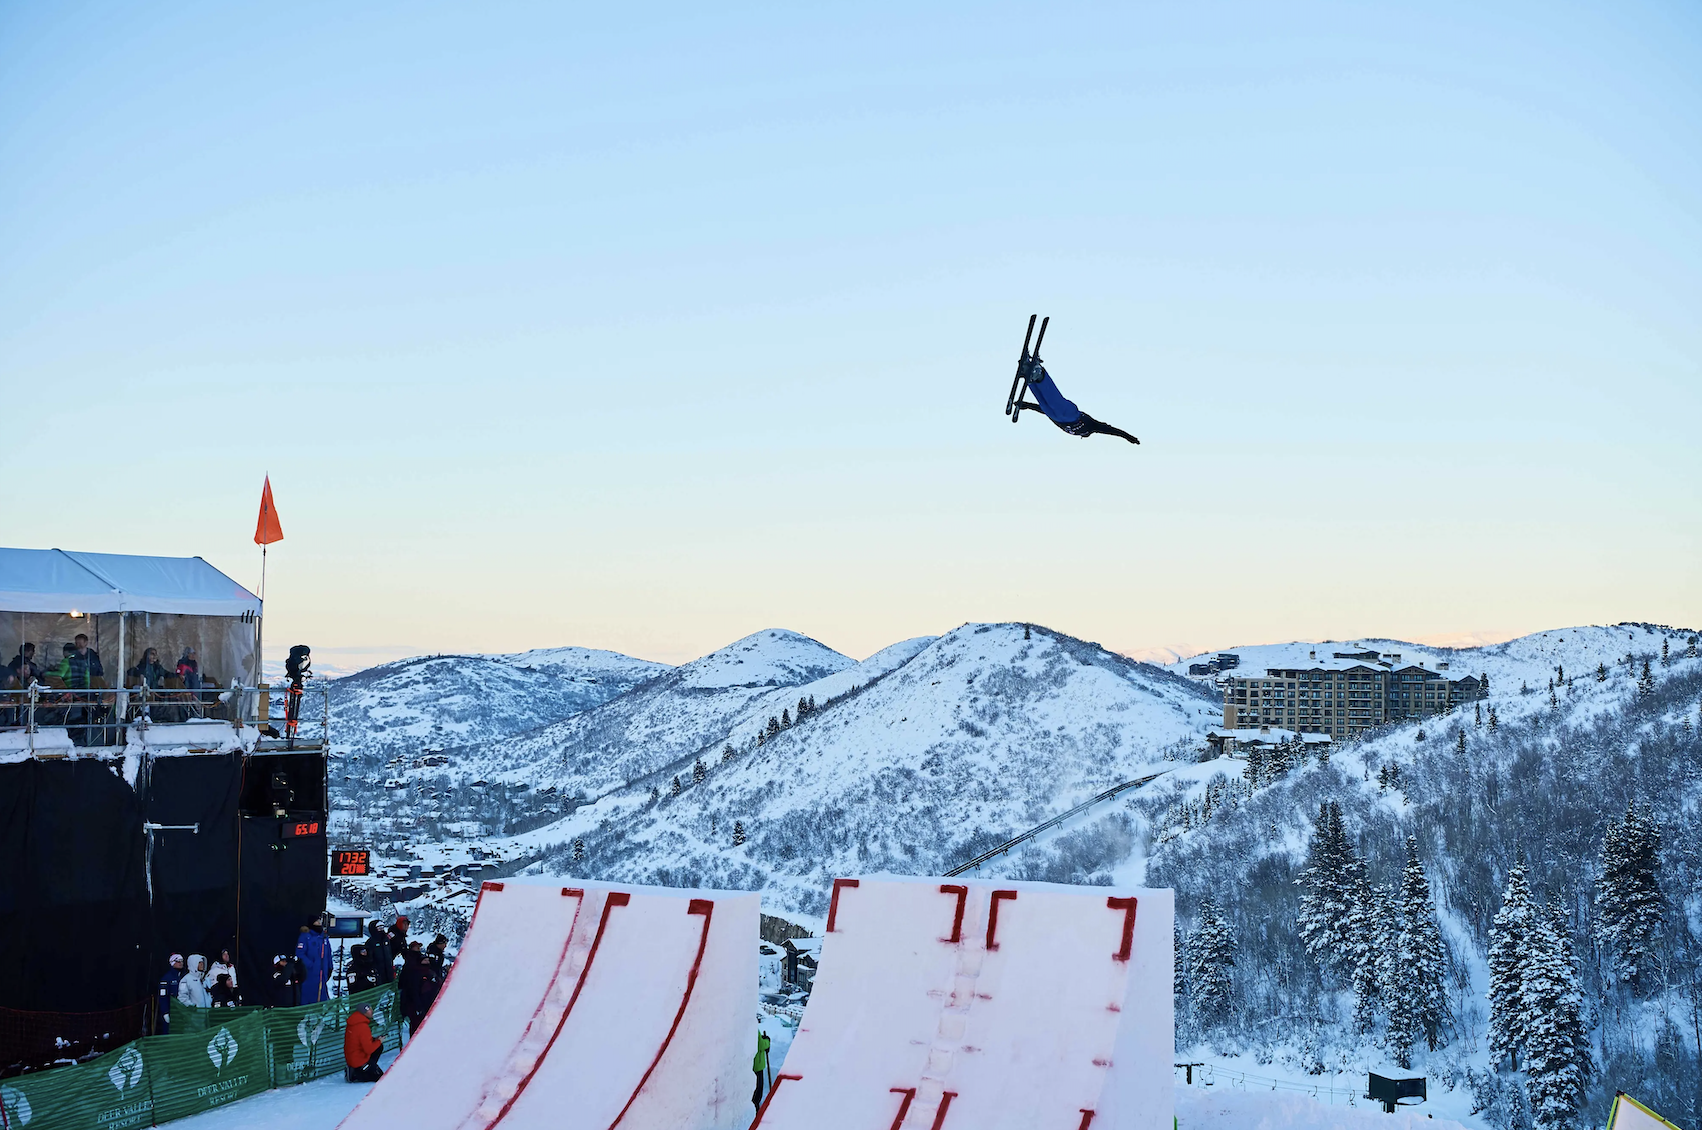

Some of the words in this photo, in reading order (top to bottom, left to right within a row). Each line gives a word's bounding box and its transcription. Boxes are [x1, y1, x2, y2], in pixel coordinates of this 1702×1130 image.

[295, 823, 318, 835] 65.18
[339, 852, 366, 863] 1732
[197, 1083, 219, 1098] DEER
[219, 1074, 249, 1090] VALLEY
[209, 1090, 238, 1106] RESORT
[97, 1108, 121, 1123] DEER
[122, 1100, 155, 1116] VALLEY
[108, 1114, 142, 1130] RESORT
